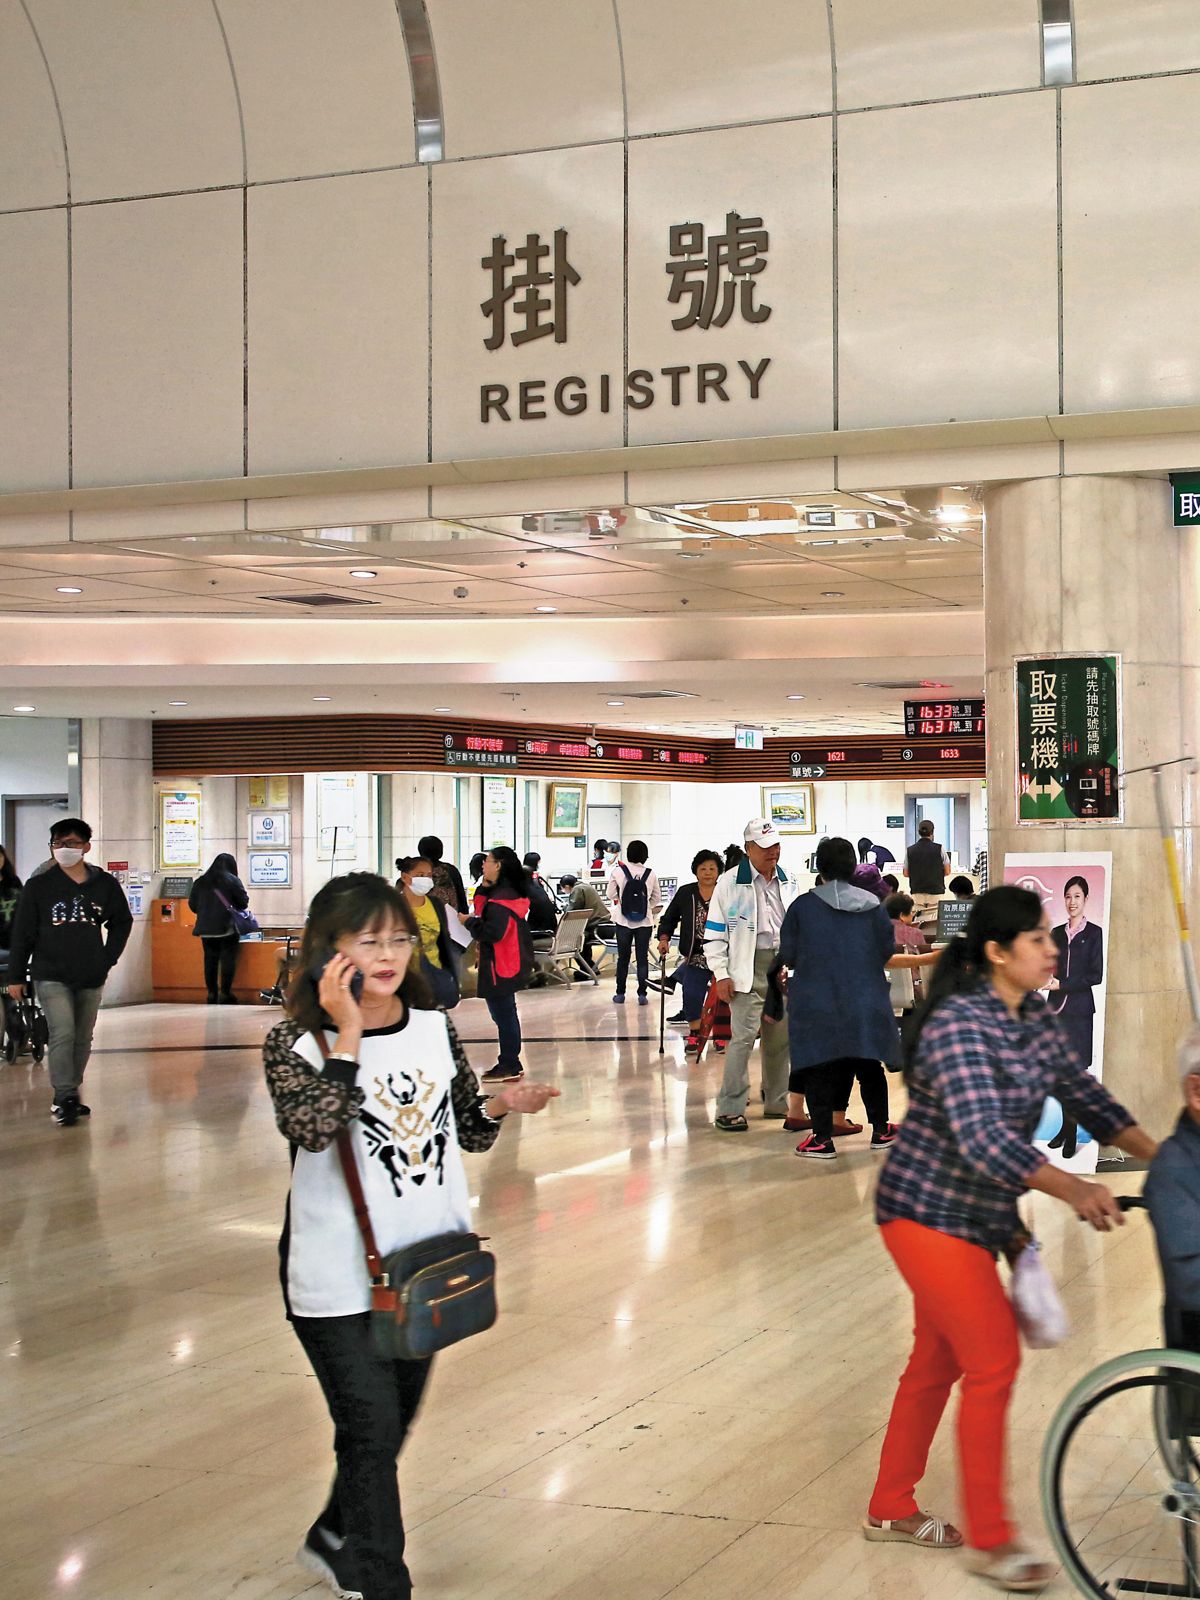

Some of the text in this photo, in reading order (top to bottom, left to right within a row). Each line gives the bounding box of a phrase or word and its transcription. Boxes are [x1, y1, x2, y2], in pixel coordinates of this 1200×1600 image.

[480, 211, 772, 350] 掛號
[480, 358, 771, 423] REGISTRY
[920, 705, 952, 718] 1633
[1086, 667, 1100, 756] 請先抽取號碼牌
[921, 720, 953, 734] 1631
[1029, 670, 1059, 770] 取票機
[827, 751, 846, 761] 1621
[940, 749, 960, 759] 1633
[792, 767, 812, 778] 單號
